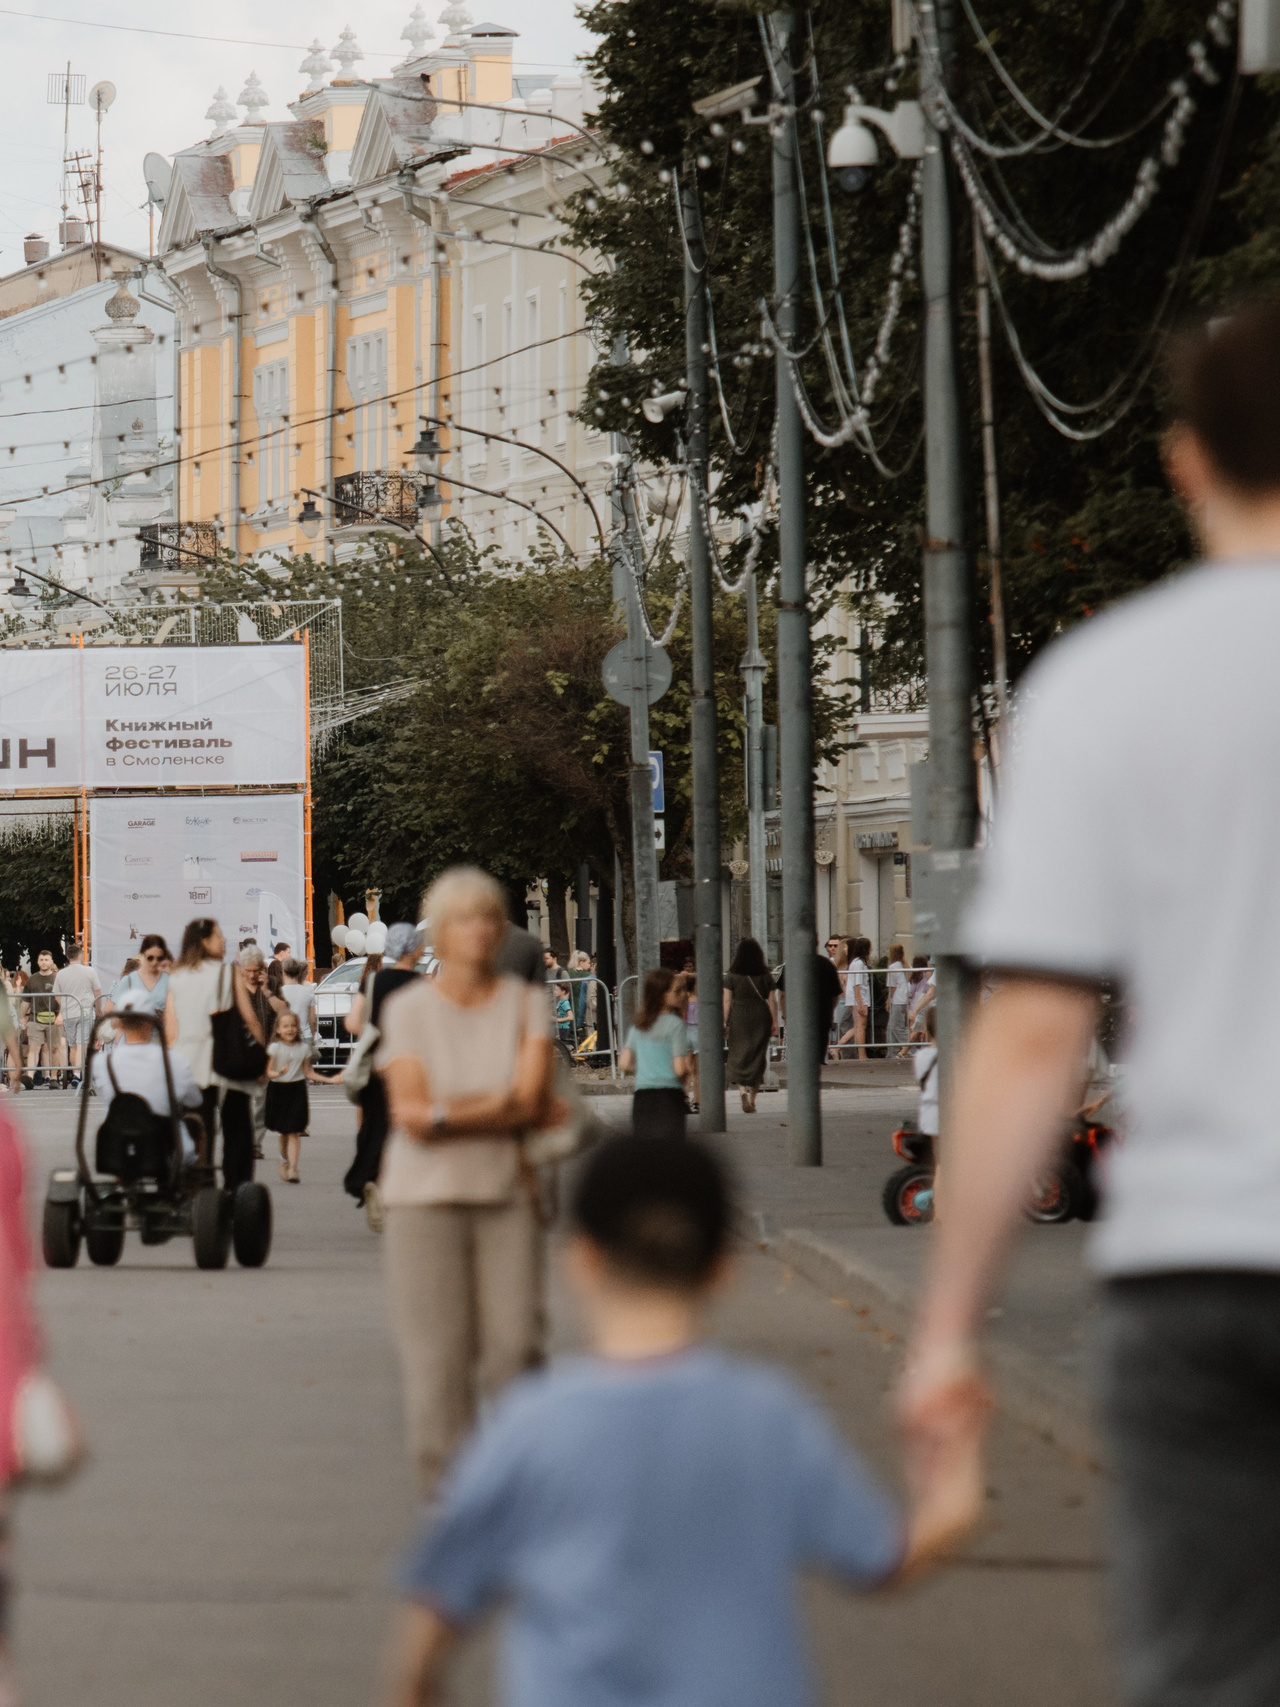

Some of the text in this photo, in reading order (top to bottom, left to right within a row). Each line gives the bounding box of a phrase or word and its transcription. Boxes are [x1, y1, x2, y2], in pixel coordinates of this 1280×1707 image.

[105, 665, 177, 680] 26-27
[105, 682, 177, 697] ИЮЛЯ
[105, 717, 213, 732] Книжный
[105, 737, 233, 752] фестиваль
[106, 755, 224, 766] в Смоленске
